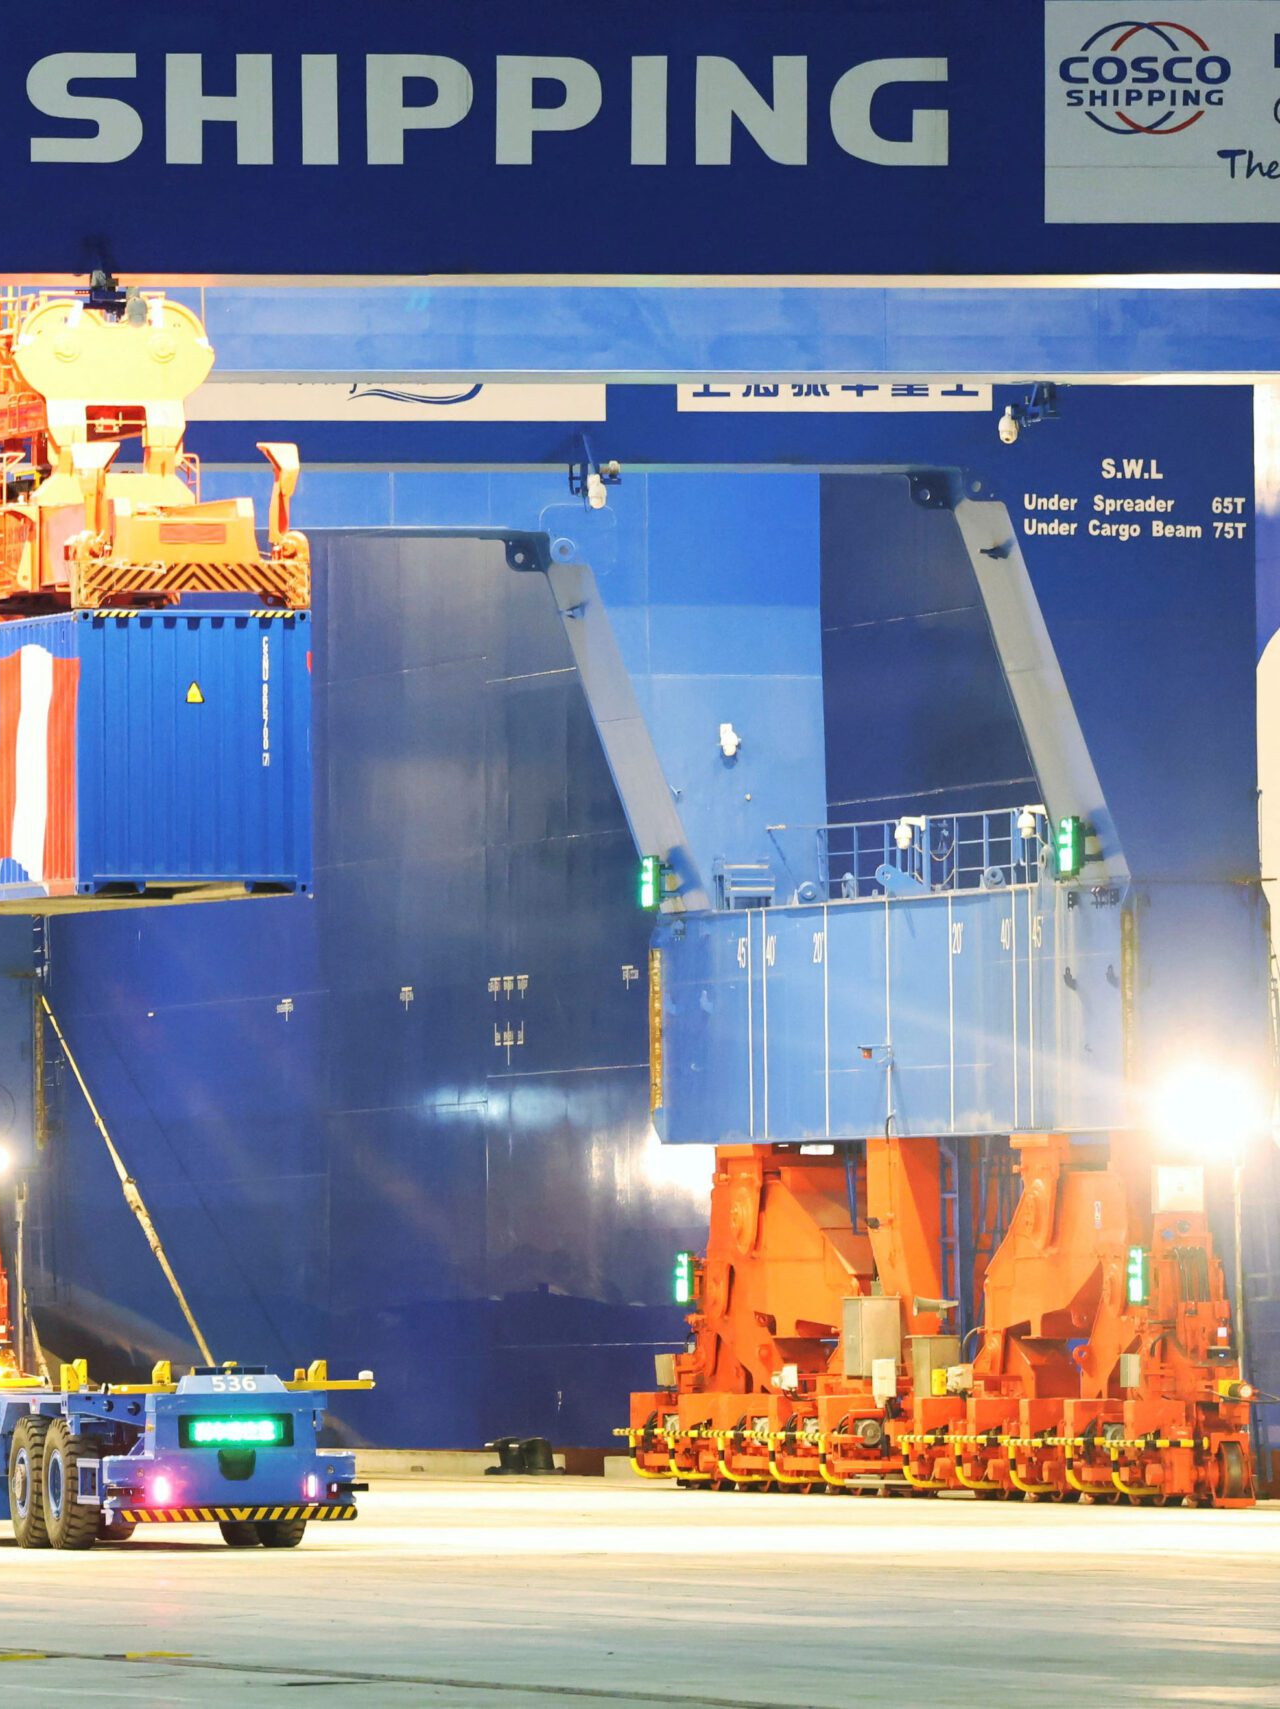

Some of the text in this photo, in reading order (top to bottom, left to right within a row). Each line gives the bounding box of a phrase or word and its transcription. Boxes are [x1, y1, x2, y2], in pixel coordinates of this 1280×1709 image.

[1059, 55, 1231, 85] COSCO
[26, 52, 949, 166] SHIPPING
[1066, 89, 1224, 107] SHIPPING
[1217, 149, 1280, 180] The
[1101, 458, 1163, 479] S.W.L
[1024, 493, 1246, 515] Under Spreader 65T
[1024, 518, 1247, 541] Under Cargo Beam 75T
[212, 1376, 257, 1392] 536
